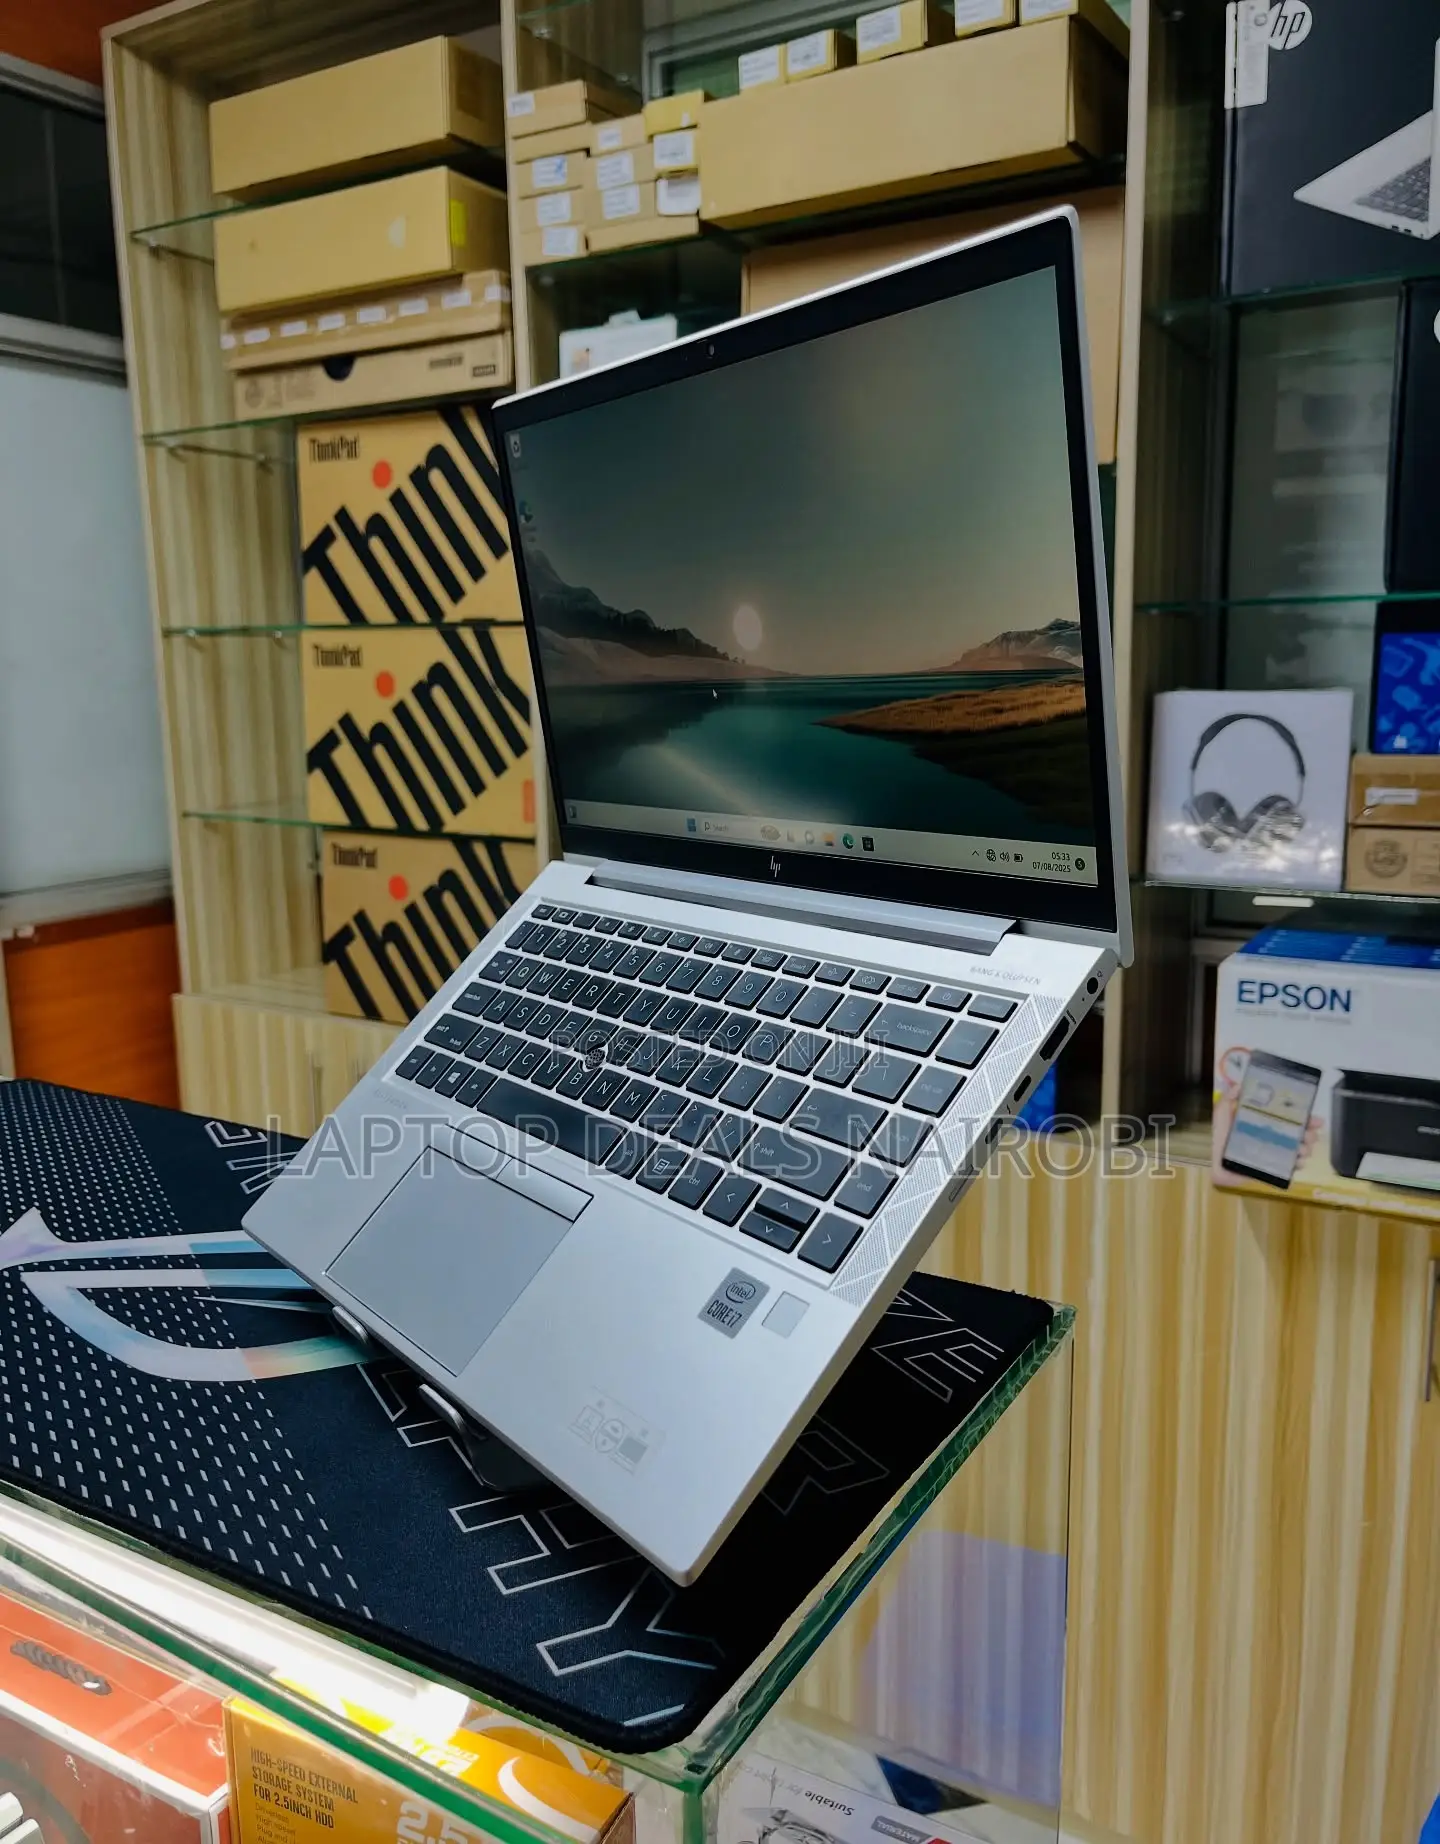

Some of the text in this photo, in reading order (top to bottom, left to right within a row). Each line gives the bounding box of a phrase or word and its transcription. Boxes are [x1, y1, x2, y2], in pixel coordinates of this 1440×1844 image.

[1270, 1, 1305, 49] hp
[306, 626, 531, 832] Think
[1237, 980, 1352, 1012] EPSON
[707, 1300, 734, 1325] CORE
[250, 1747, 359, 1804] HIGH-SPEED EXTERNAL
[252, 1766, 335, 1813] STORAGE SYSTEM
[253, 1783, 335, 1829] FOR 2.5INCH HDD
[804, 1789, 855, 1817] Suitable
